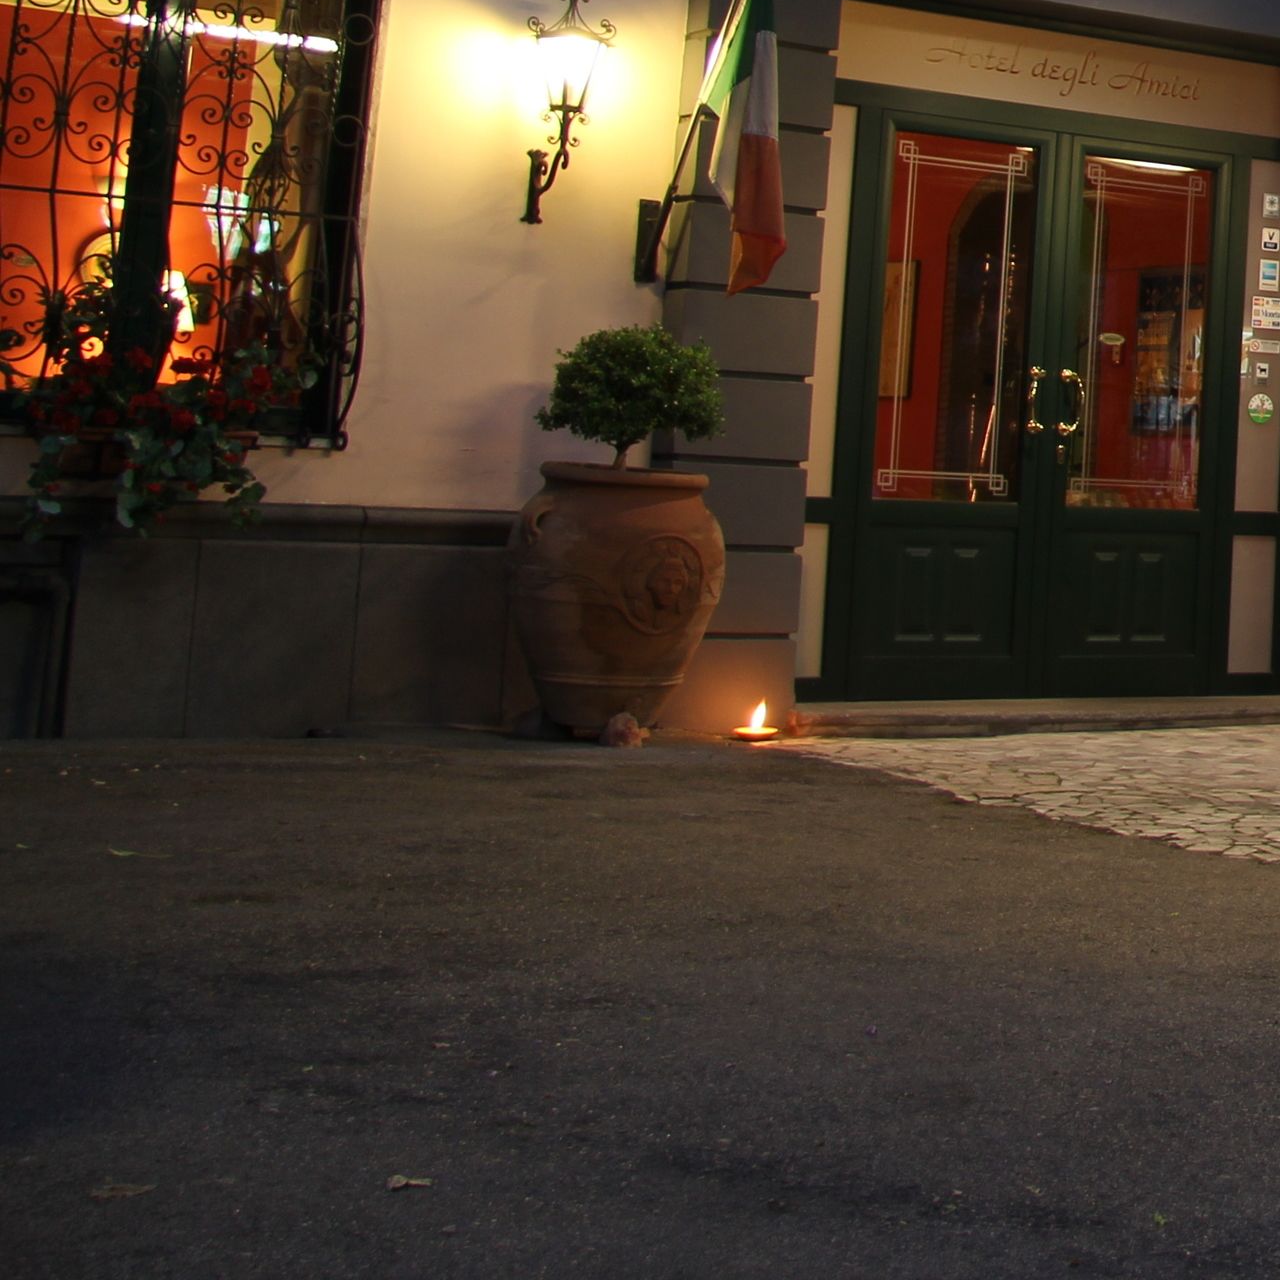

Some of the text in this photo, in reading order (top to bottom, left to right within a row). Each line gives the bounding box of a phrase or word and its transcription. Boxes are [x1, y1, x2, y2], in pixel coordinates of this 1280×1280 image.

[925, 39, 1201, 101] Hotel degli Amici
